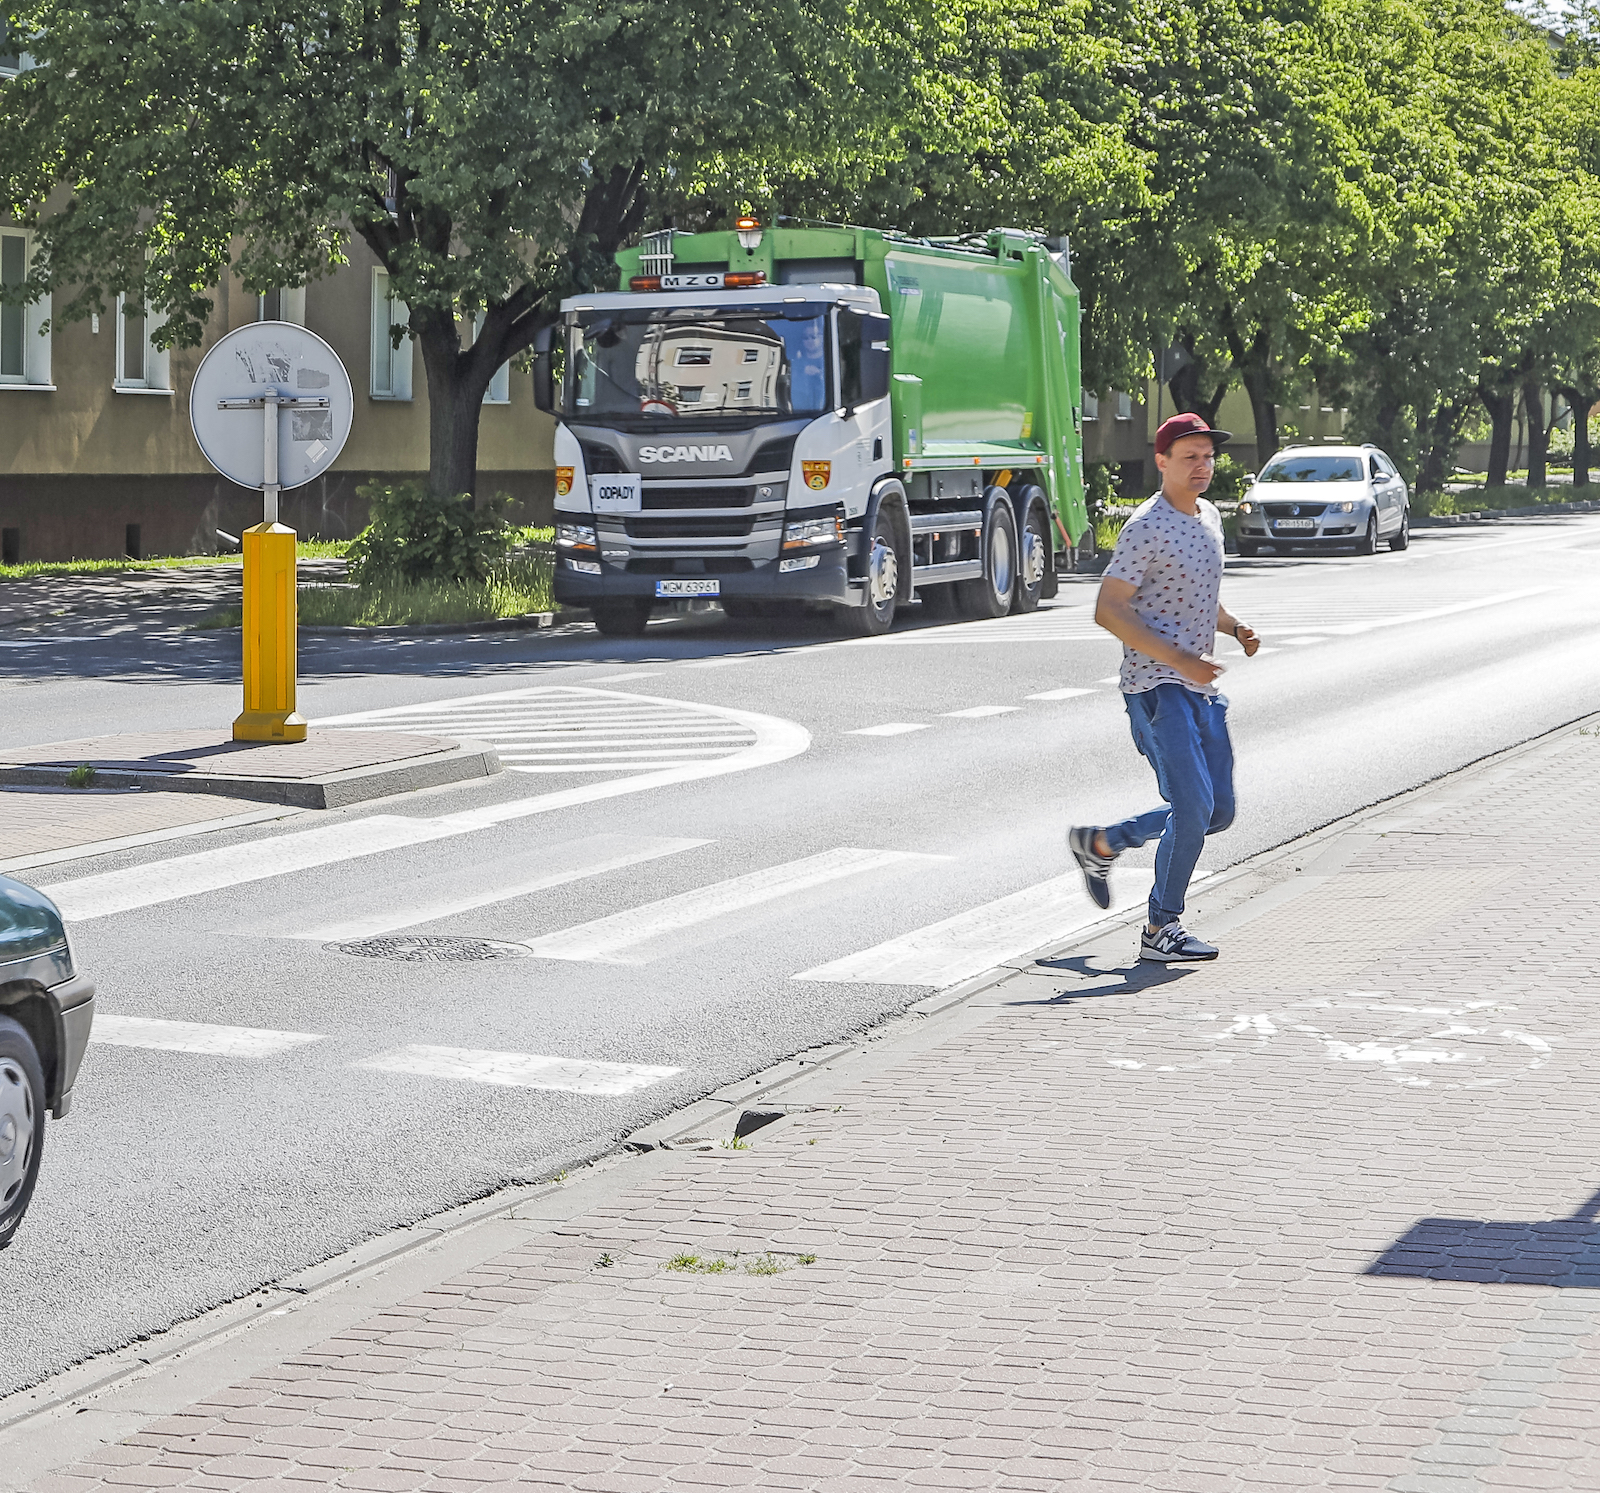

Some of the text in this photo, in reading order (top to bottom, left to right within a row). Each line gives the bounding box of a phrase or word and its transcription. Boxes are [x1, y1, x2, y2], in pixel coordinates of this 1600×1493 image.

[638, 445, 734, 463] SCANIA
[599, 486, 635, 500] ODPADY
[686, 582, 717, 593] 63961
